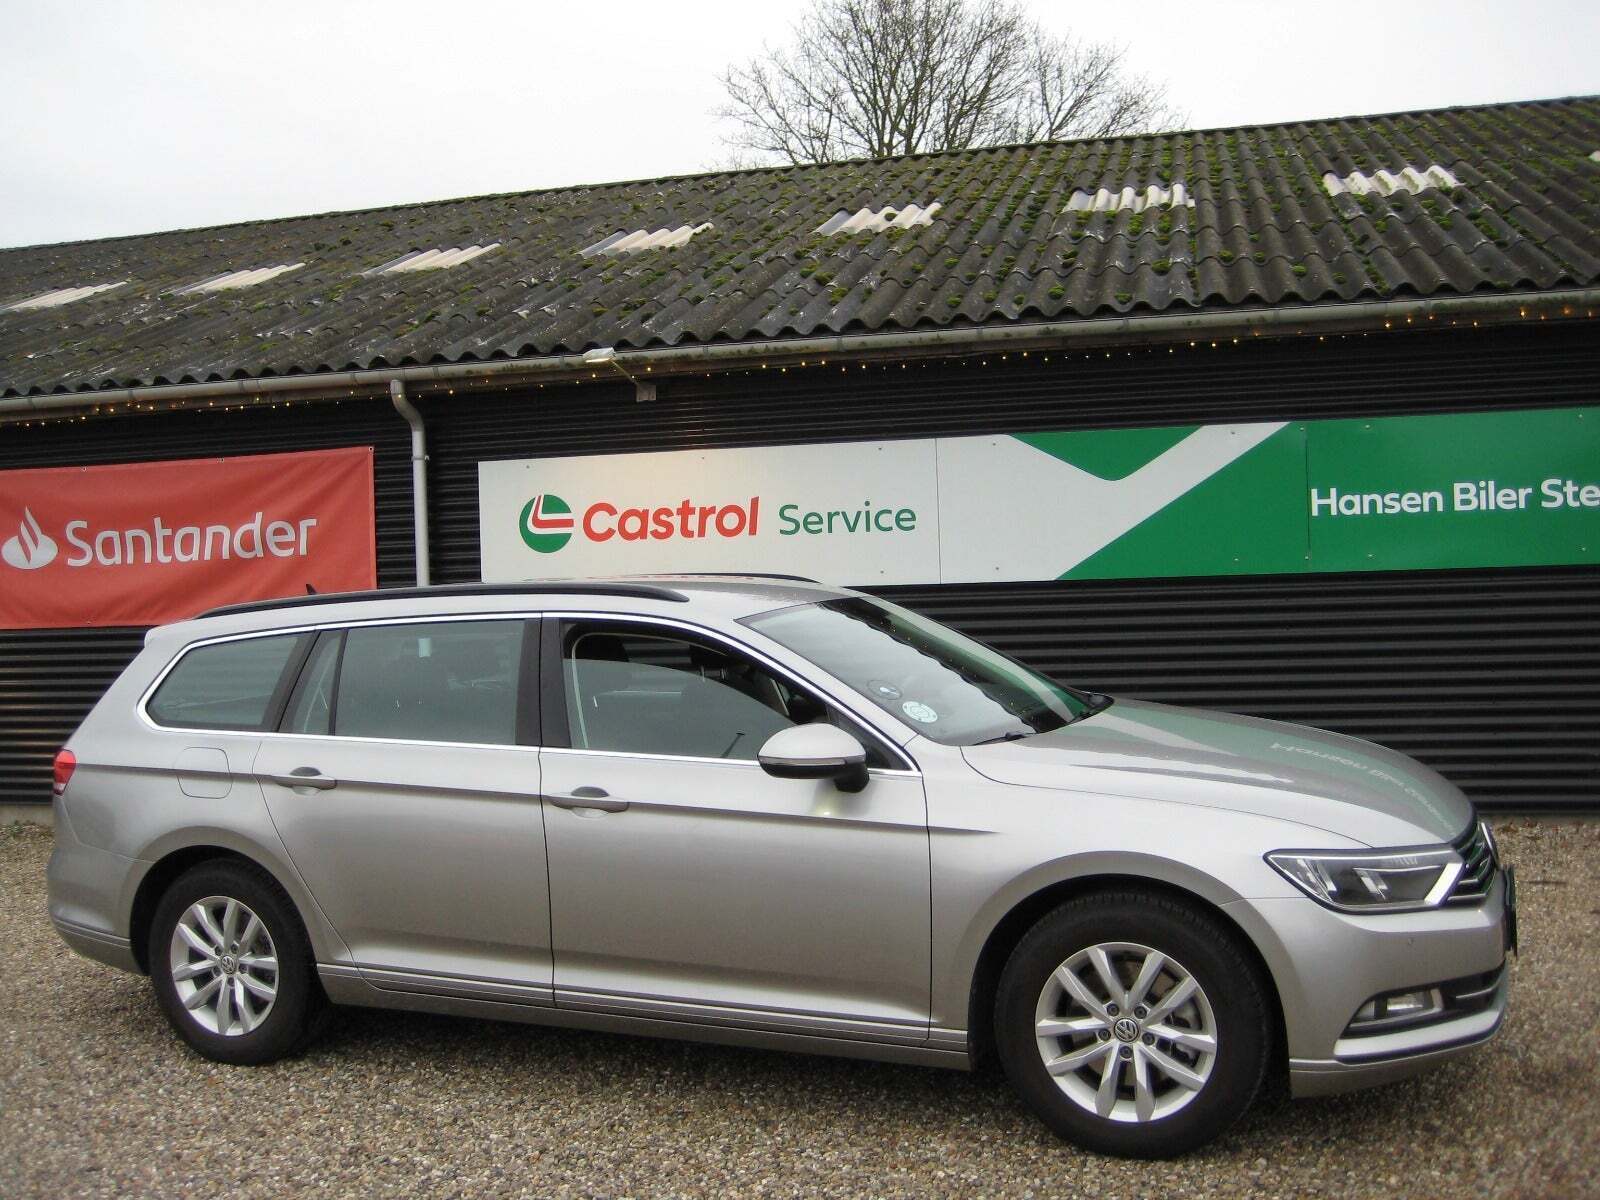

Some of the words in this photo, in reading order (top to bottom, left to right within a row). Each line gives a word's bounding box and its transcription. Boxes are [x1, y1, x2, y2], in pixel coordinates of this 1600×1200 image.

[582, 496, 760, 542] Castrol
[778, 501, 917, 536] Service
[1310, 487, 1444, 517] Hansen
[1453, 480, 1533, 512] Biler
[1540, 478, 1600, 508] Ste
[65, 511, 318, 567] Santander
